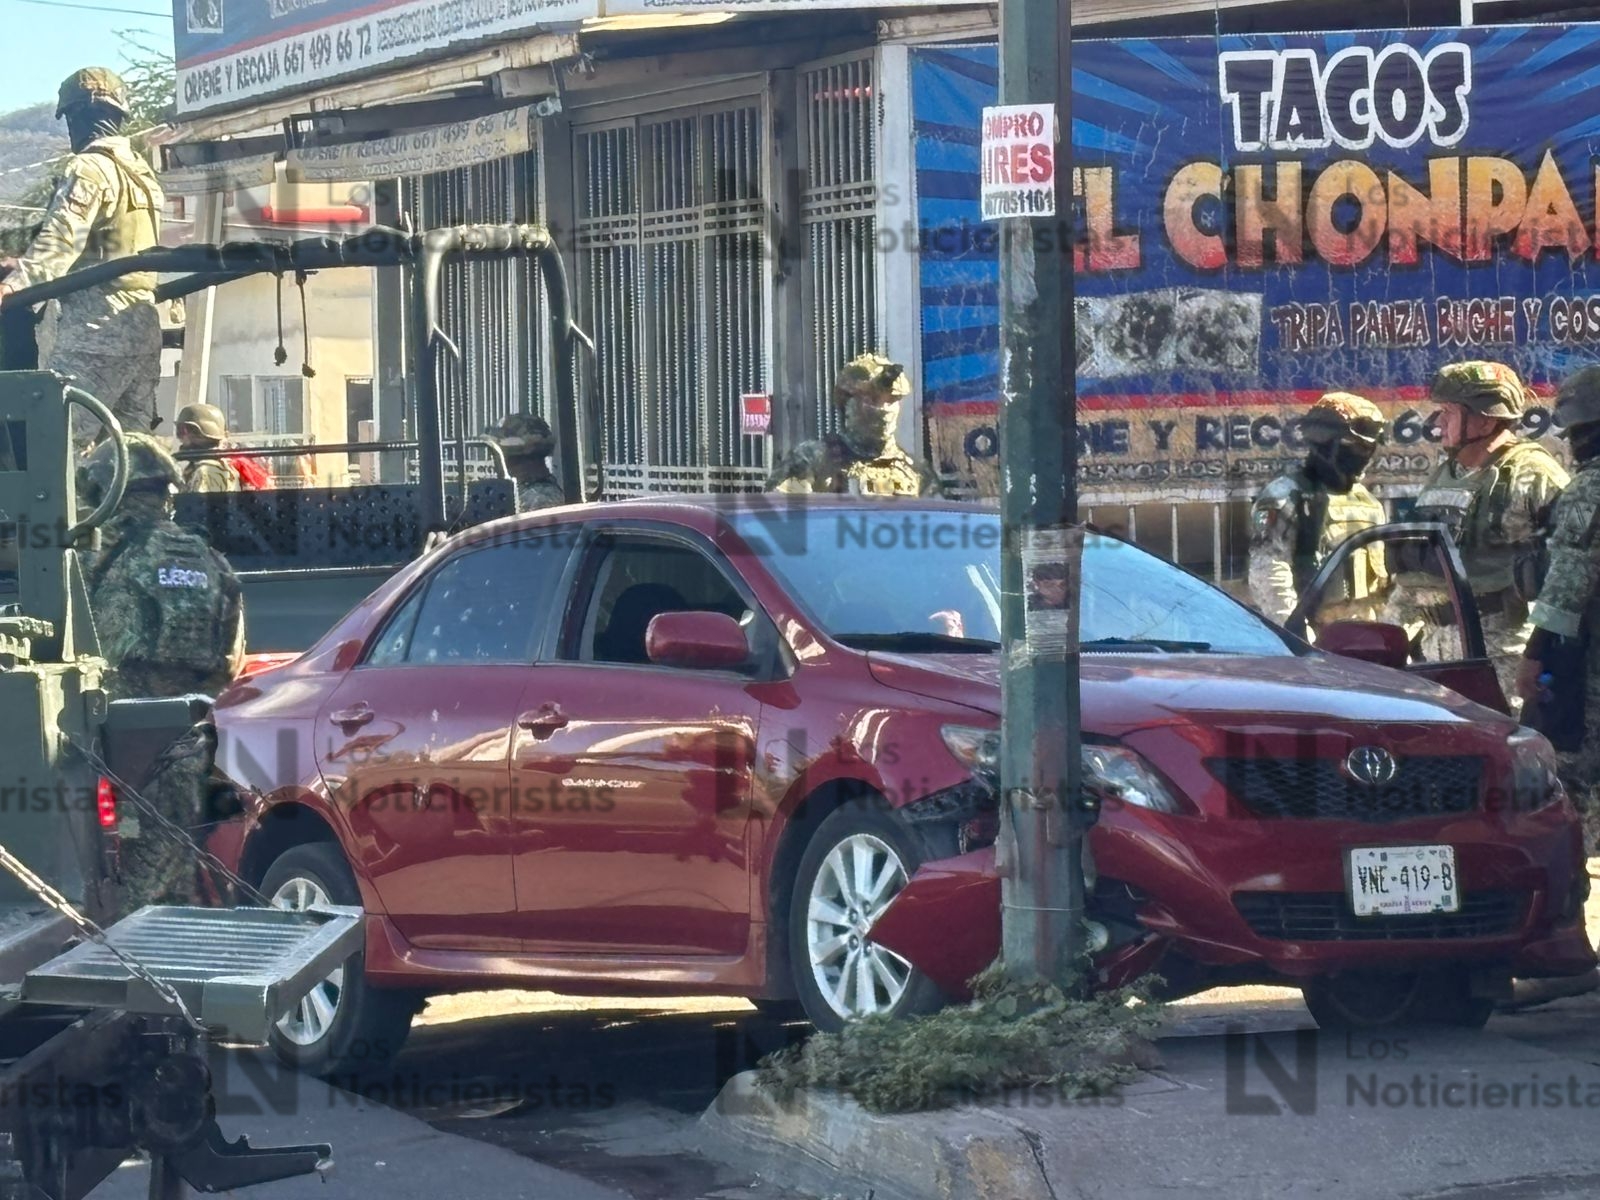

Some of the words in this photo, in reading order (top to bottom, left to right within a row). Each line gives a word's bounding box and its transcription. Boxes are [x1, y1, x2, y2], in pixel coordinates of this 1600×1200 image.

[283, 40, 306, 76] 667
[309, 32, 332, 70] 499
[336, 28, 353, 62] 66
[1218, 42, 1473, 152] TACOS
[984, 111, 1044, 140] OMPRO
[983, 143, 1053, 187] IRES
[1073, 165, 1141, 273] L
[1162, 146, 1600, 270] CHONPA
[1271, 299, 1345, 352] TRIPA
[1350, 297, 1432, 349] PANZA
[1522, 297, 1543, 344] Y
[1151, 419, 1177, 451] Y
